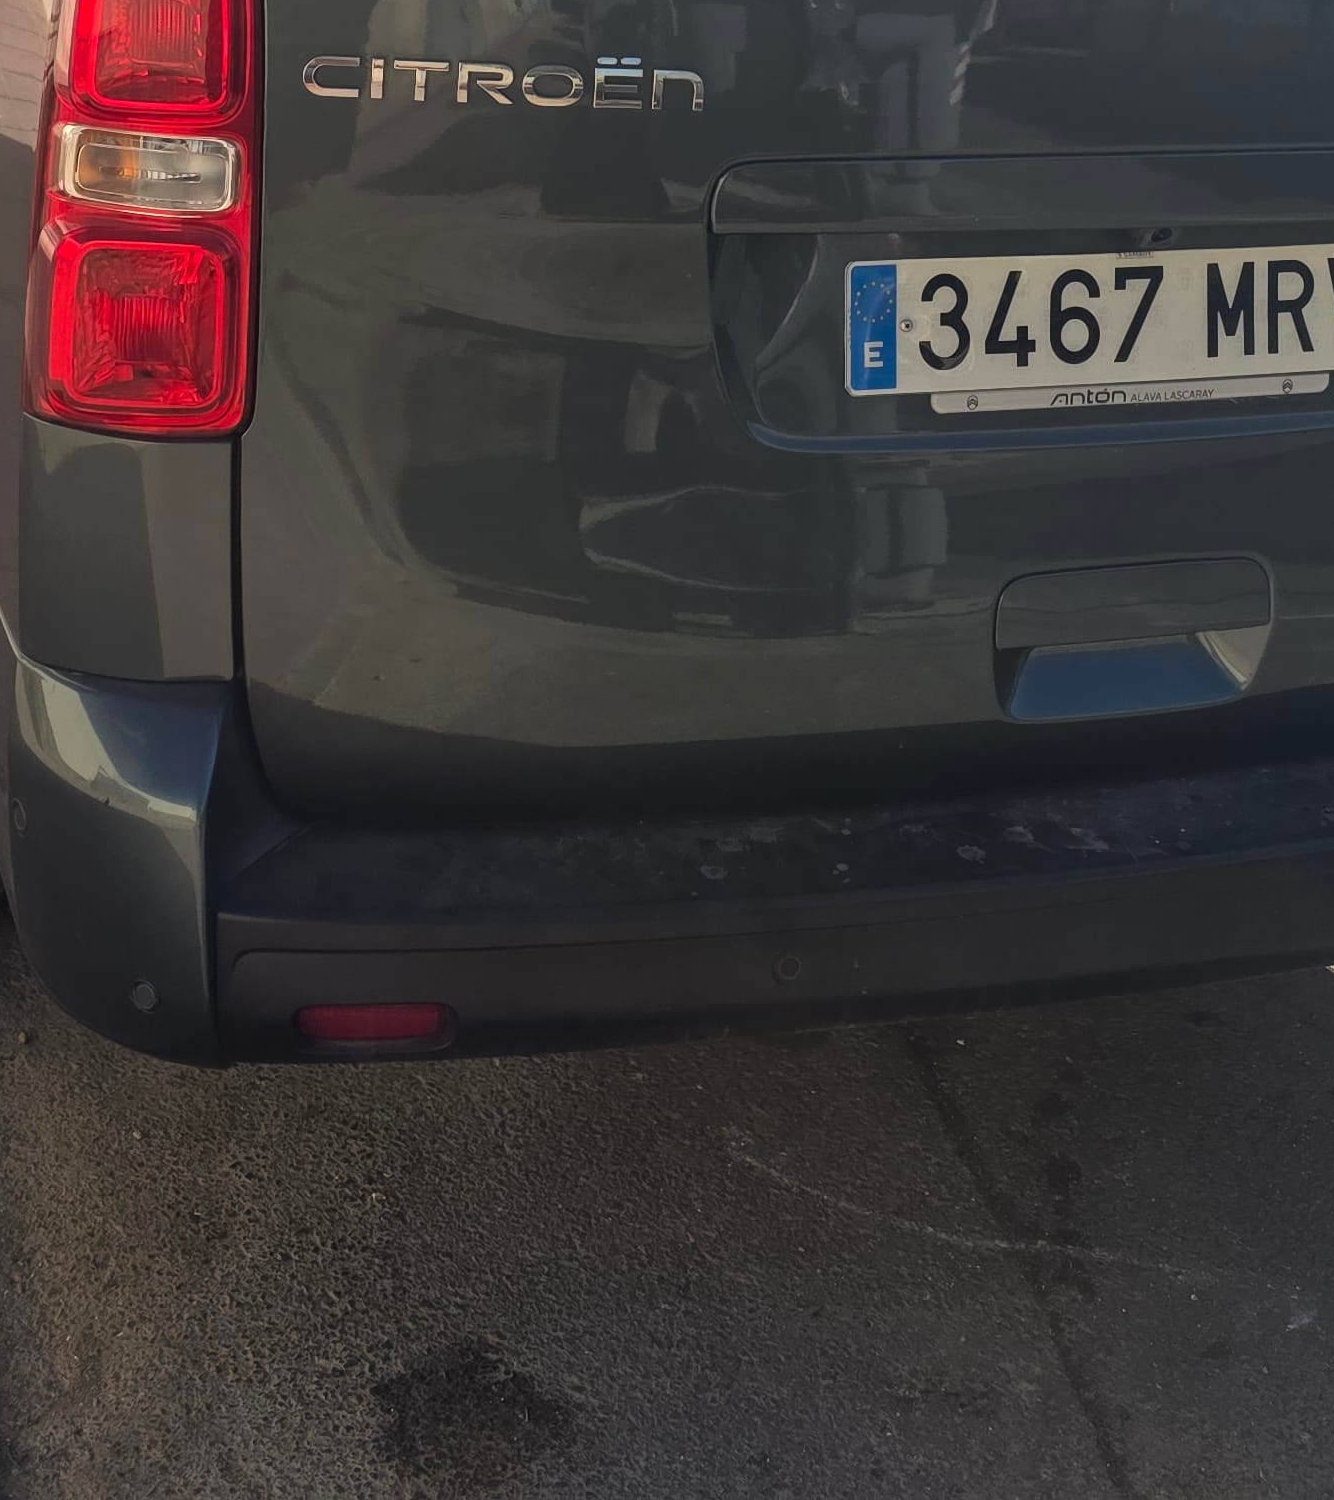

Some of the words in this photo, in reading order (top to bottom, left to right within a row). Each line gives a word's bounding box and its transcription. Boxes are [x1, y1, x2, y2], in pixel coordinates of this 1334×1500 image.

[918, 264, 1165, 371] 3467
[862, 341, 885, 368] E
[1130, 392, 1162, 402] ALAVA
[1164, 388, 1215, 401] LASCARAY
